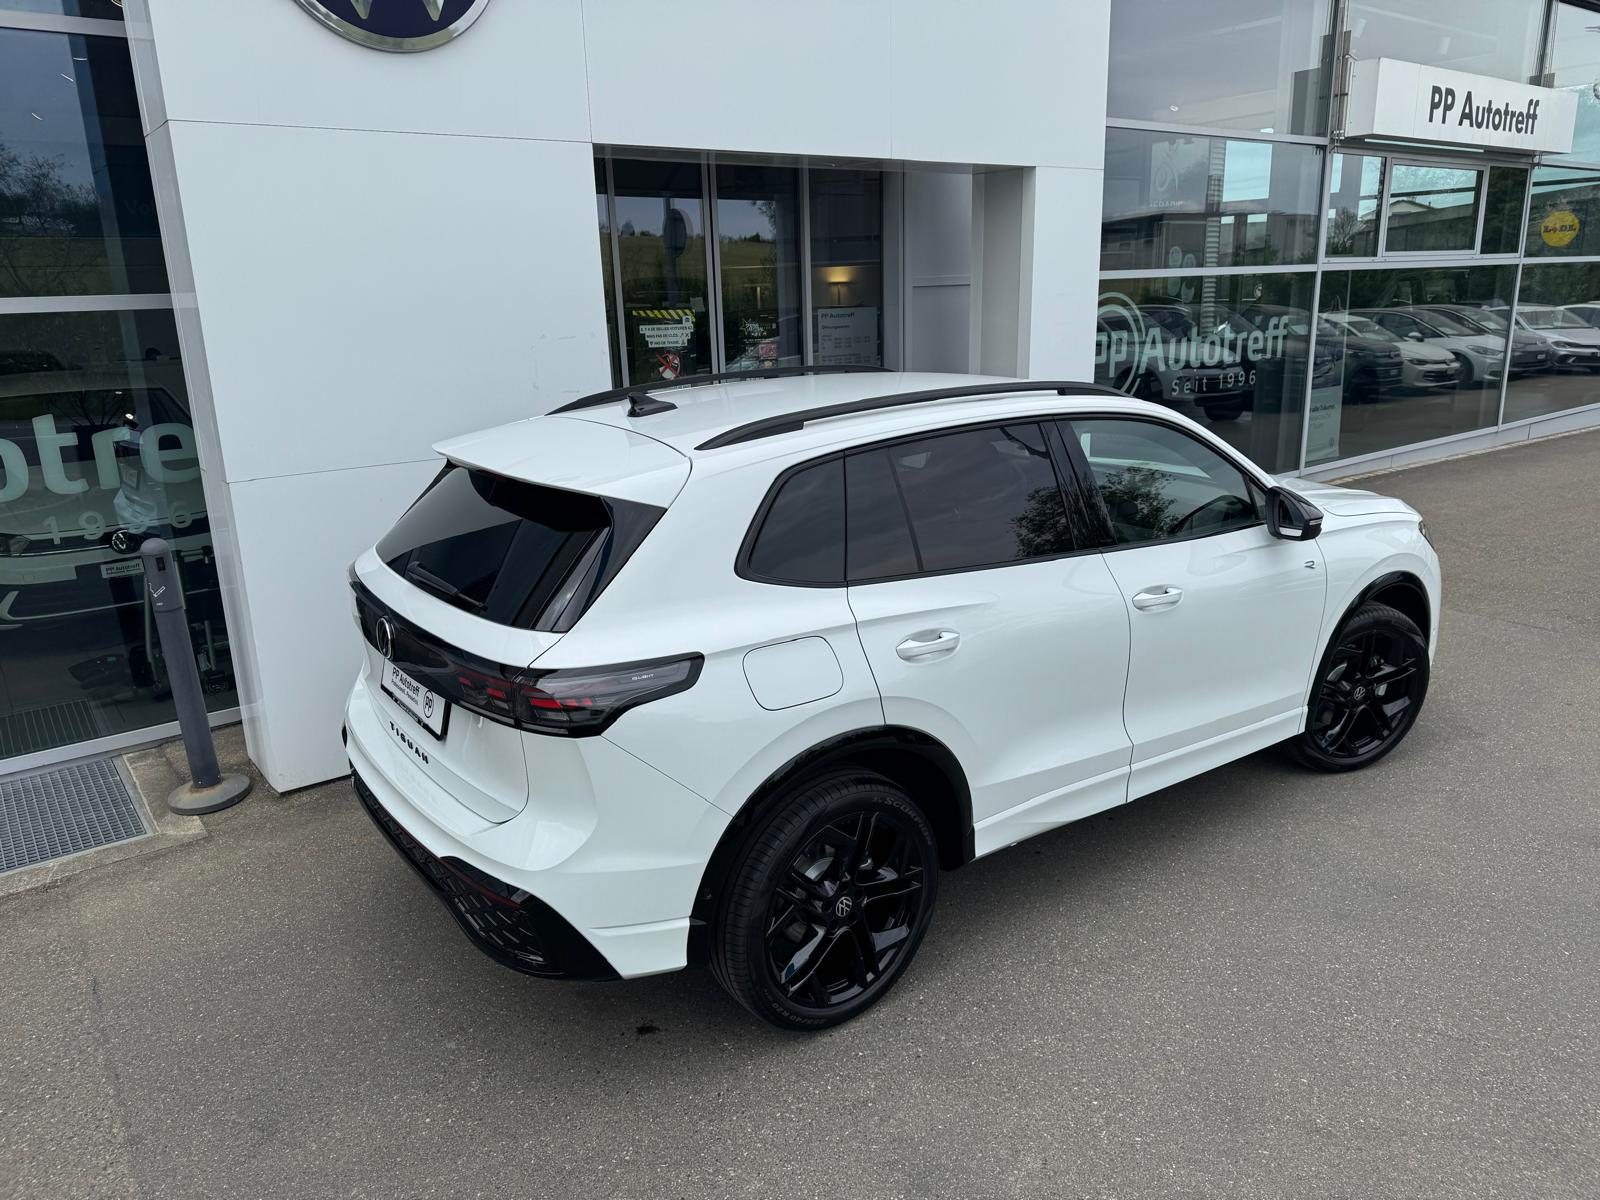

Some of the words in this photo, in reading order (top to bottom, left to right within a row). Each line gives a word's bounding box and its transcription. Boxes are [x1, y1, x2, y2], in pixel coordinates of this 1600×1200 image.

[1428, 85, 1456, 124] PP
[1458, 91, 1540, 135] Autotreff
[1139, 315, 1289, 375] Autotreff
[1171, 376, 1208, 396] Seit
[1218, 369, 1257, 388] 1996
[392, 667, 400, 679] PP
[400, 673, 421, 697] Autotreff
[390, 721, 430, 764] TIGUAN
